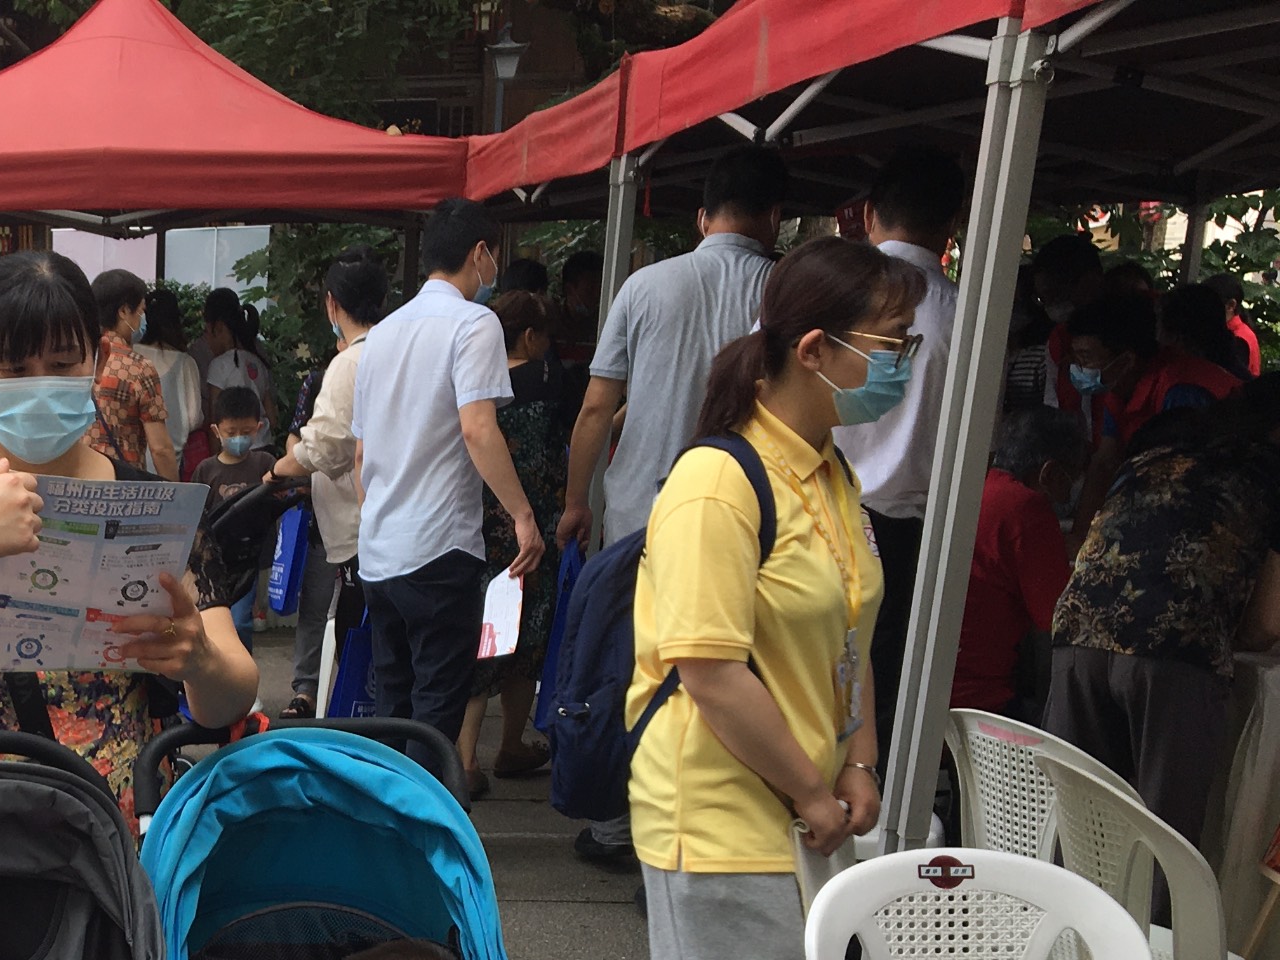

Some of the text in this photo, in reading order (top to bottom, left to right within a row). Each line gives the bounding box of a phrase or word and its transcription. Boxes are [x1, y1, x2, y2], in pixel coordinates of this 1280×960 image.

[53, 499, 161, 517] 分类投放指南
